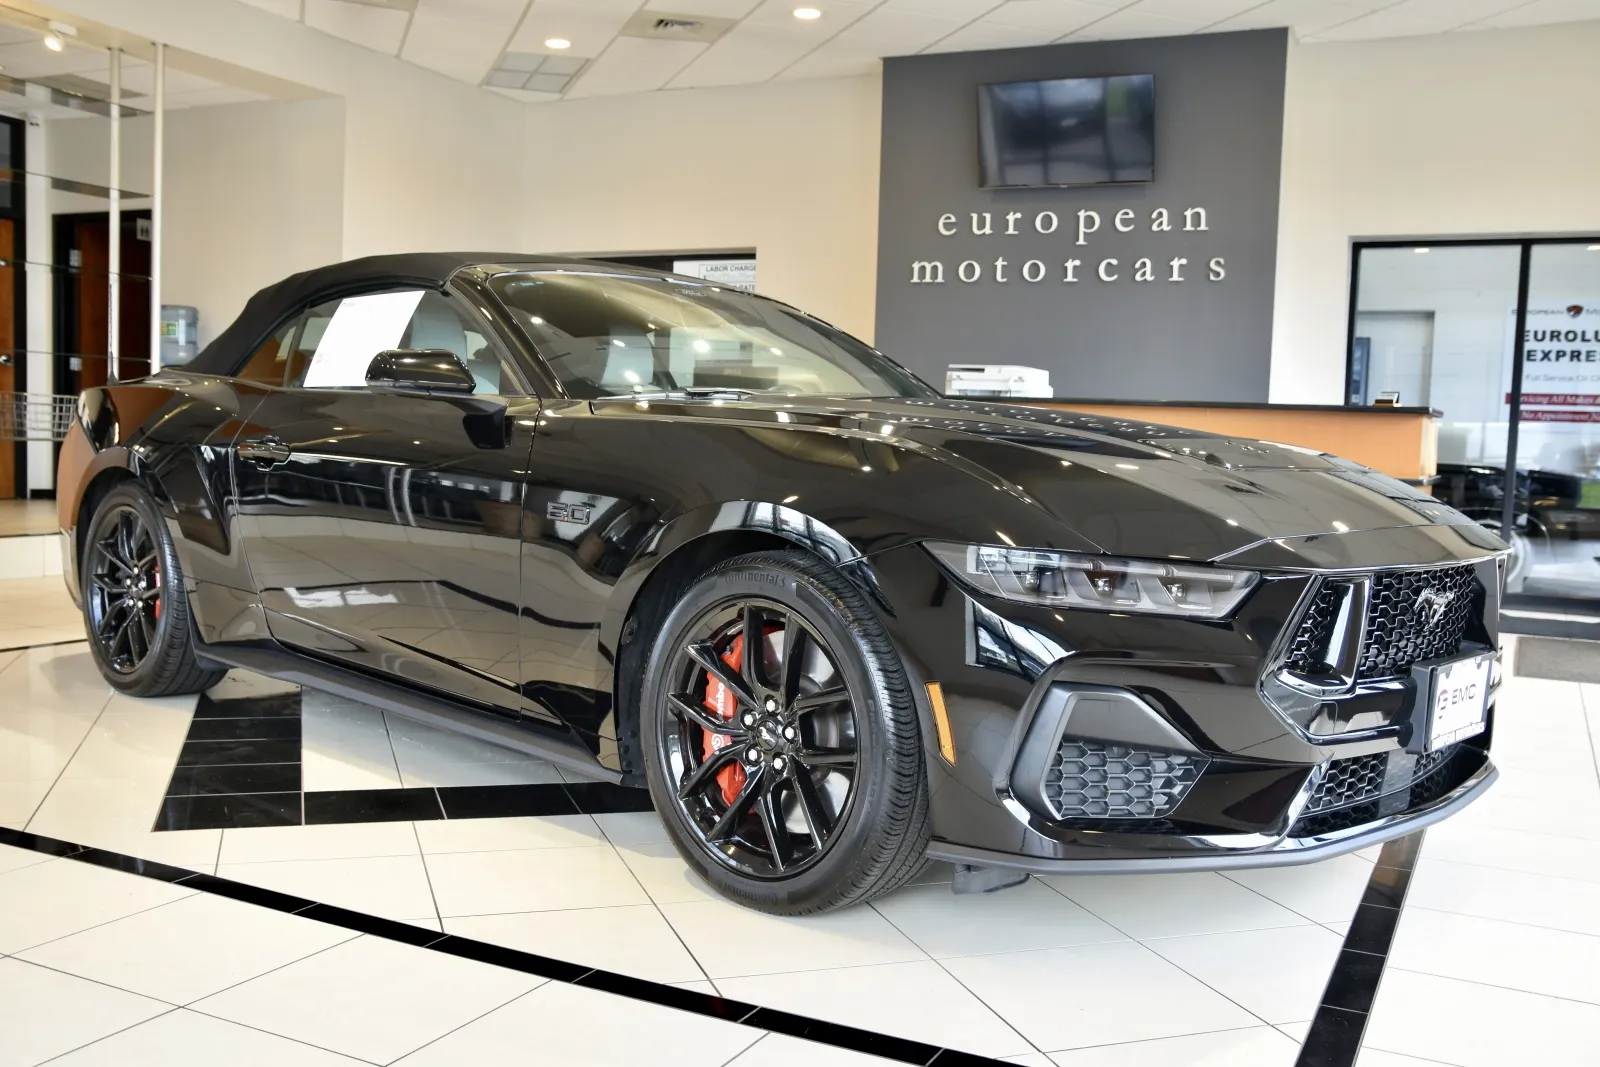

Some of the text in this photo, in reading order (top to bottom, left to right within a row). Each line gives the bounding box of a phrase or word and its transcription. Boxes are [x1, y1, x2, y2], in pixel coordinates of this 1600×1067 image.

[937, 205, 1209, 246] european
[910, 255, 1226, 283] motorcars
[1526, 349, 1600, 362] EXPRE
[1452, 684, 1477, 705] EMC
